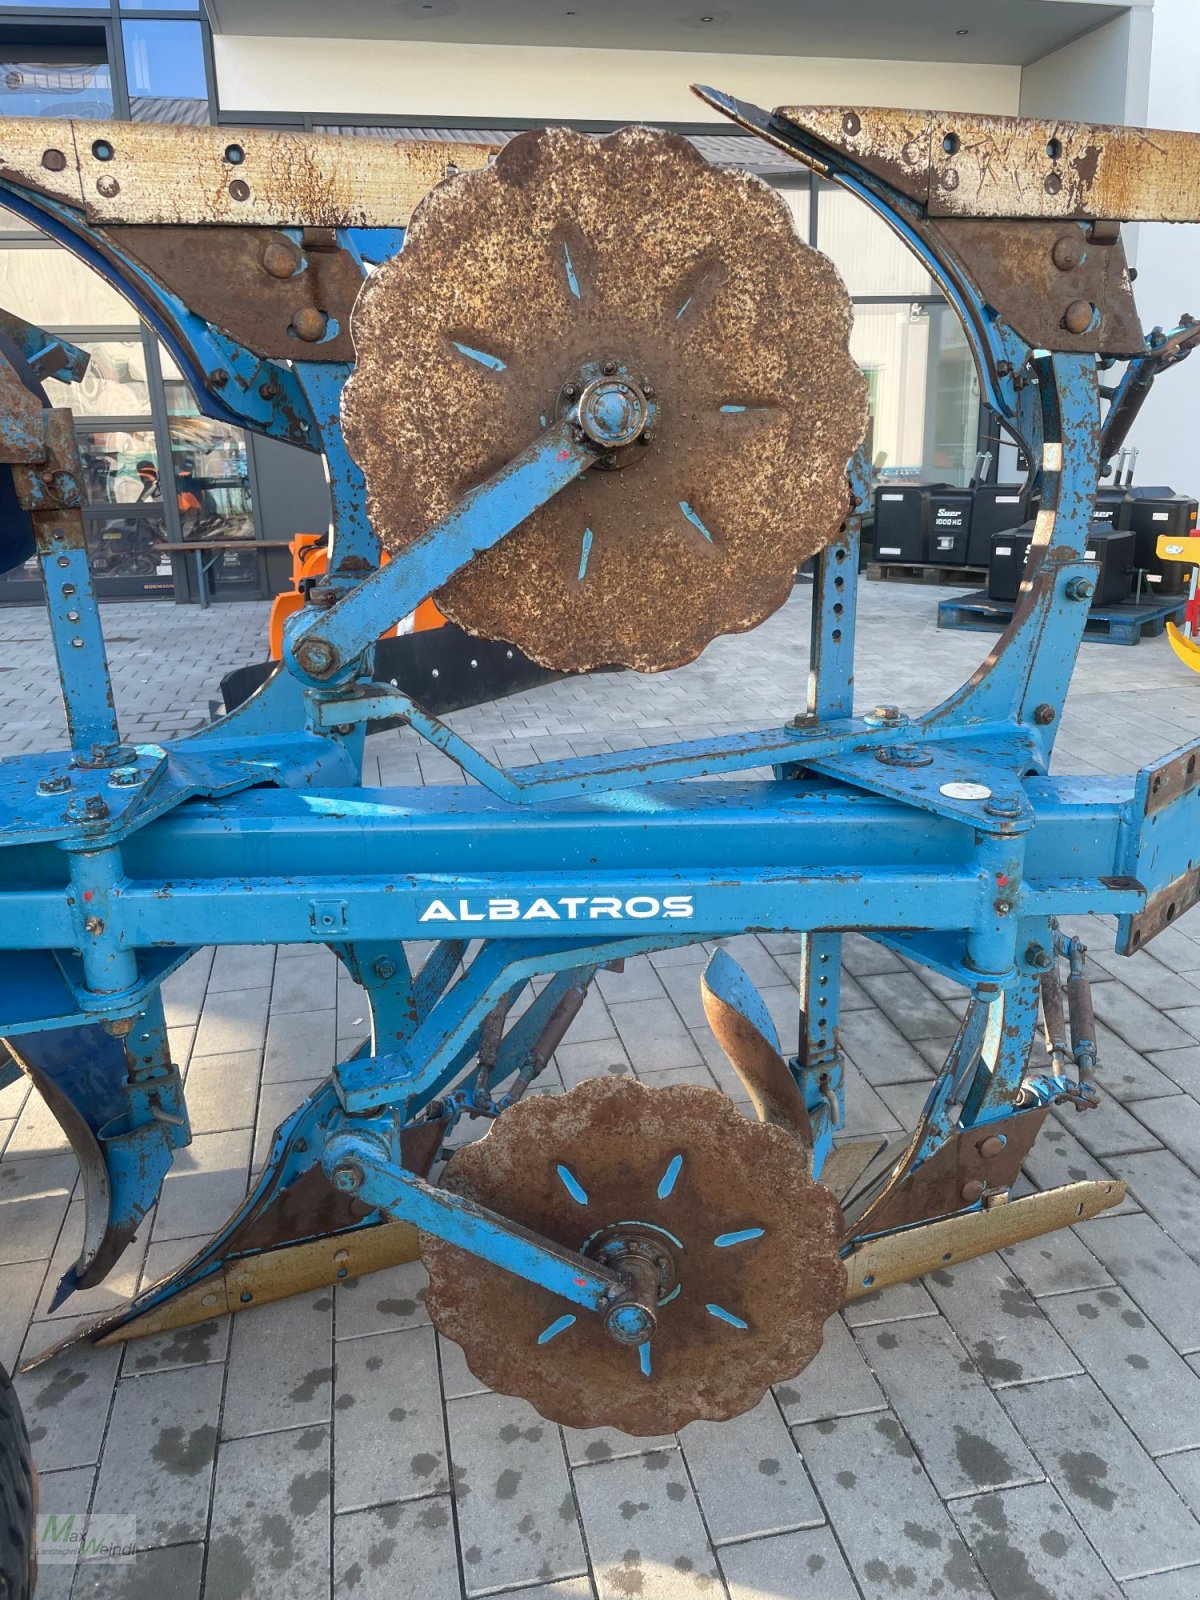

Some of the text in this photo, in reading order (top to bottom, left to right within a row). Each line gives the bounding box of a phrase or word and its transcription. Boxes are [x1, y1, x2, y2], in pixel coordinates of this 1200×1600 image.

[937, 508, 962, 517] Suer
[935, 518, 963, 526] 1000 KG
[418, 895, 694, 922] ALBATROS
